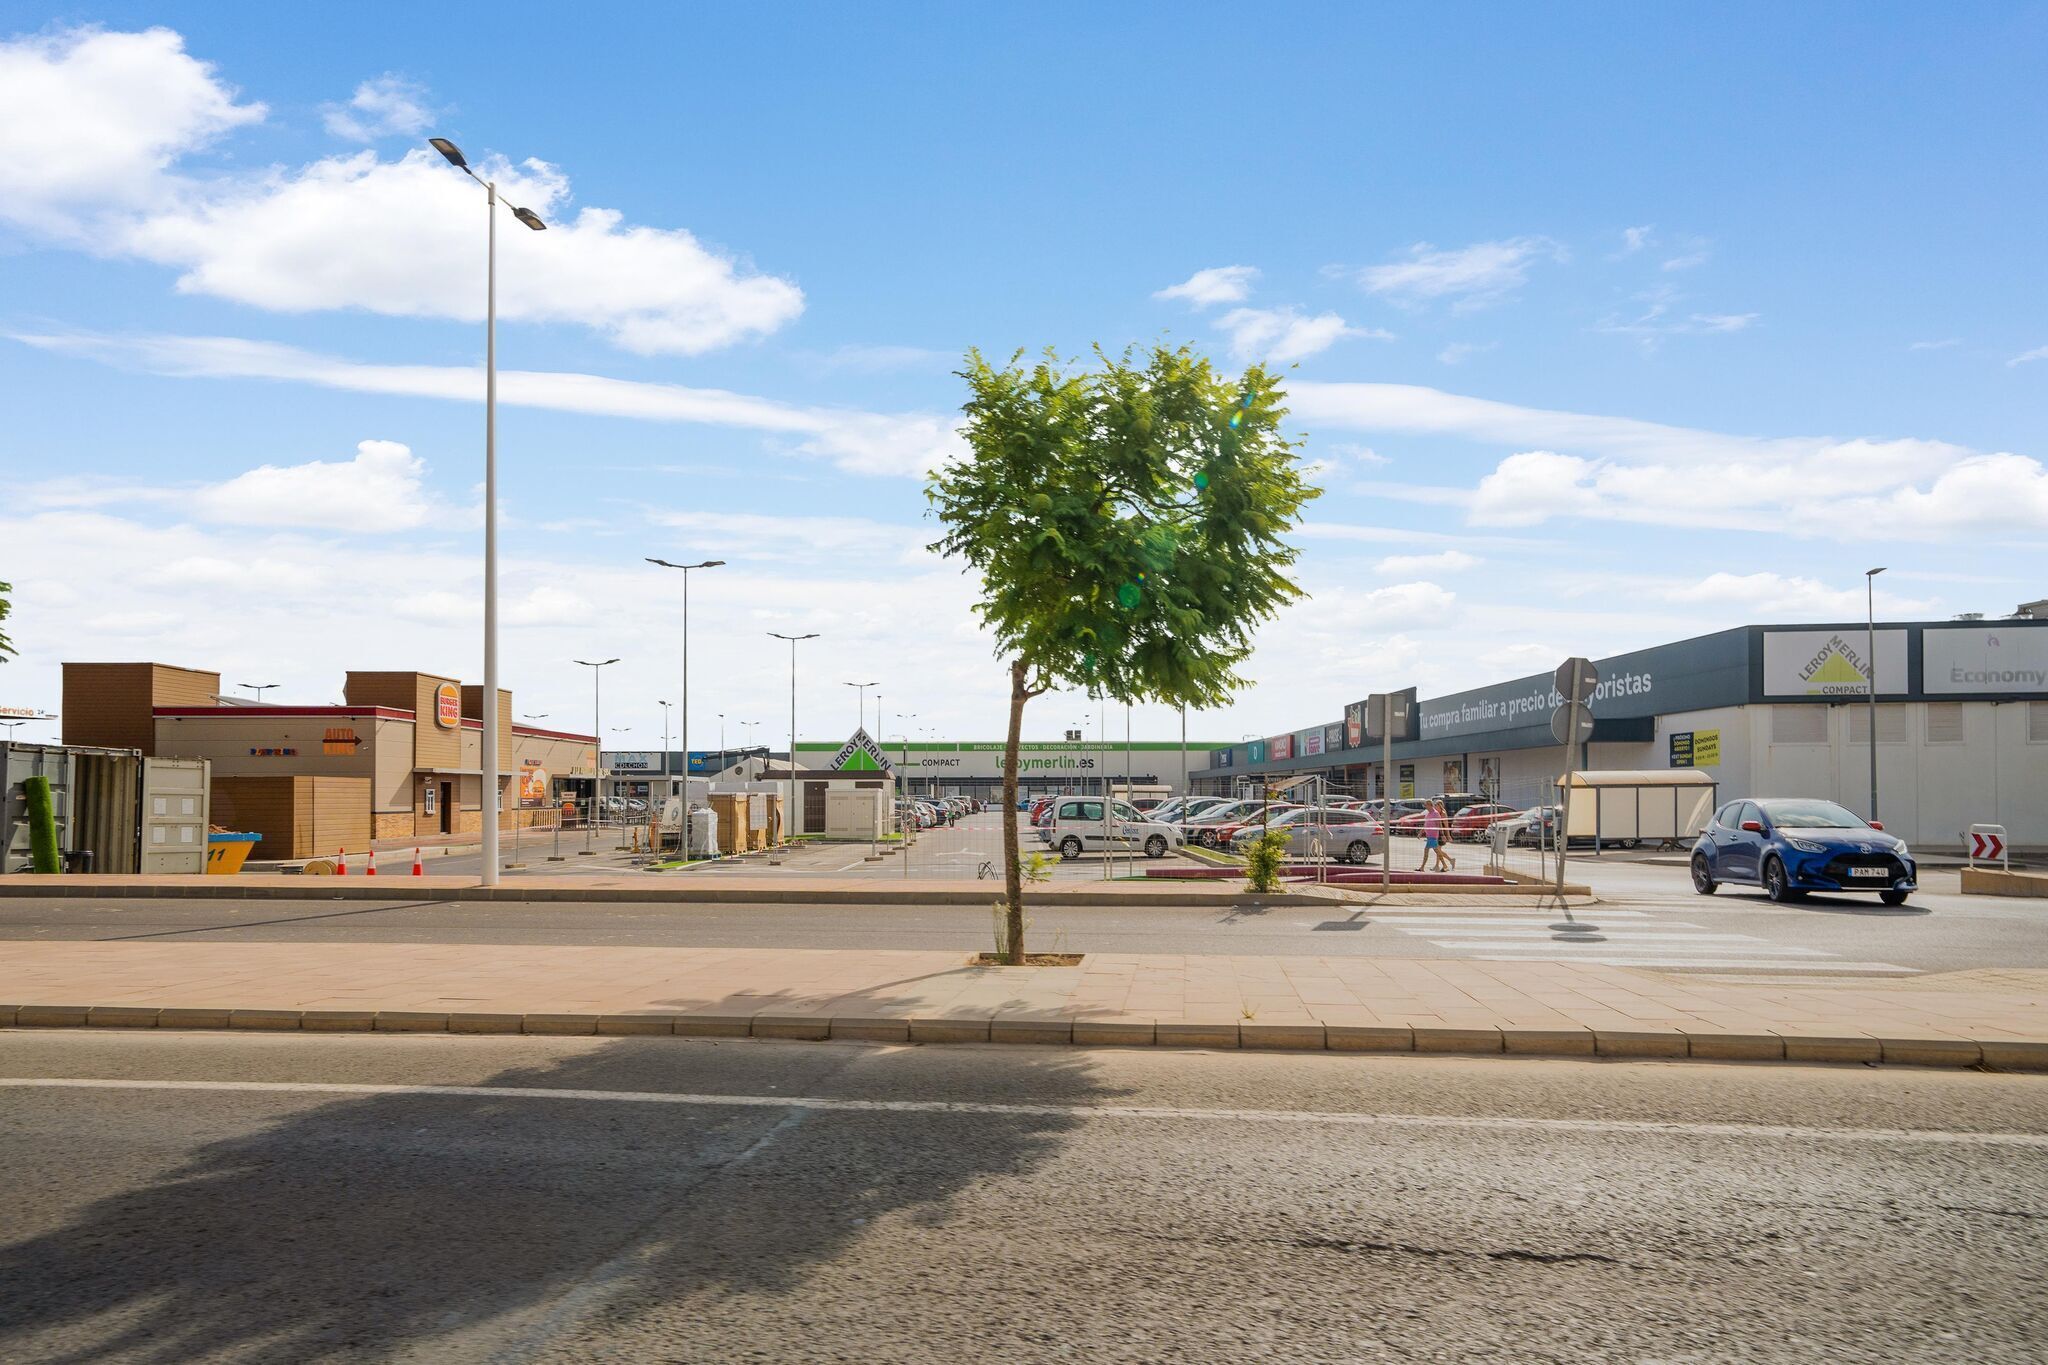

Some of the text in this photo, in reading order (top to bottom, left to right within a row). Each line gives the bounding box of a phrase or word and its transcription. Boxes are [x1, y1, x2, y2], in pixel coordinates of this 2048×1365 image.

[1798, 634, 1875, 681] LEROY MERLIN
[1951, 667, 2047, 686] Economy
[1822, 685, 1867, 695] COMPACT
[440, 696, 458, 707] BURGER
[1418, 712, 1428, 730] Tu
[1429, 710, 1461, 731] compra
[1461, 699, 1499, 722] familiar
[1500, 701, 1507, 717] a
[1508, 689, 1545, 721] precio
[1584, 673, 1652, 710] yoristas
[440, 705, 458, 718] KING
[325, 728, 354, 740] AUTO
[830, 732, 892, 771] LEROY MERLIN
[922, 759, 960, 767] COMPACT
[995, 755, 1094, 772] leoymerlin.es
